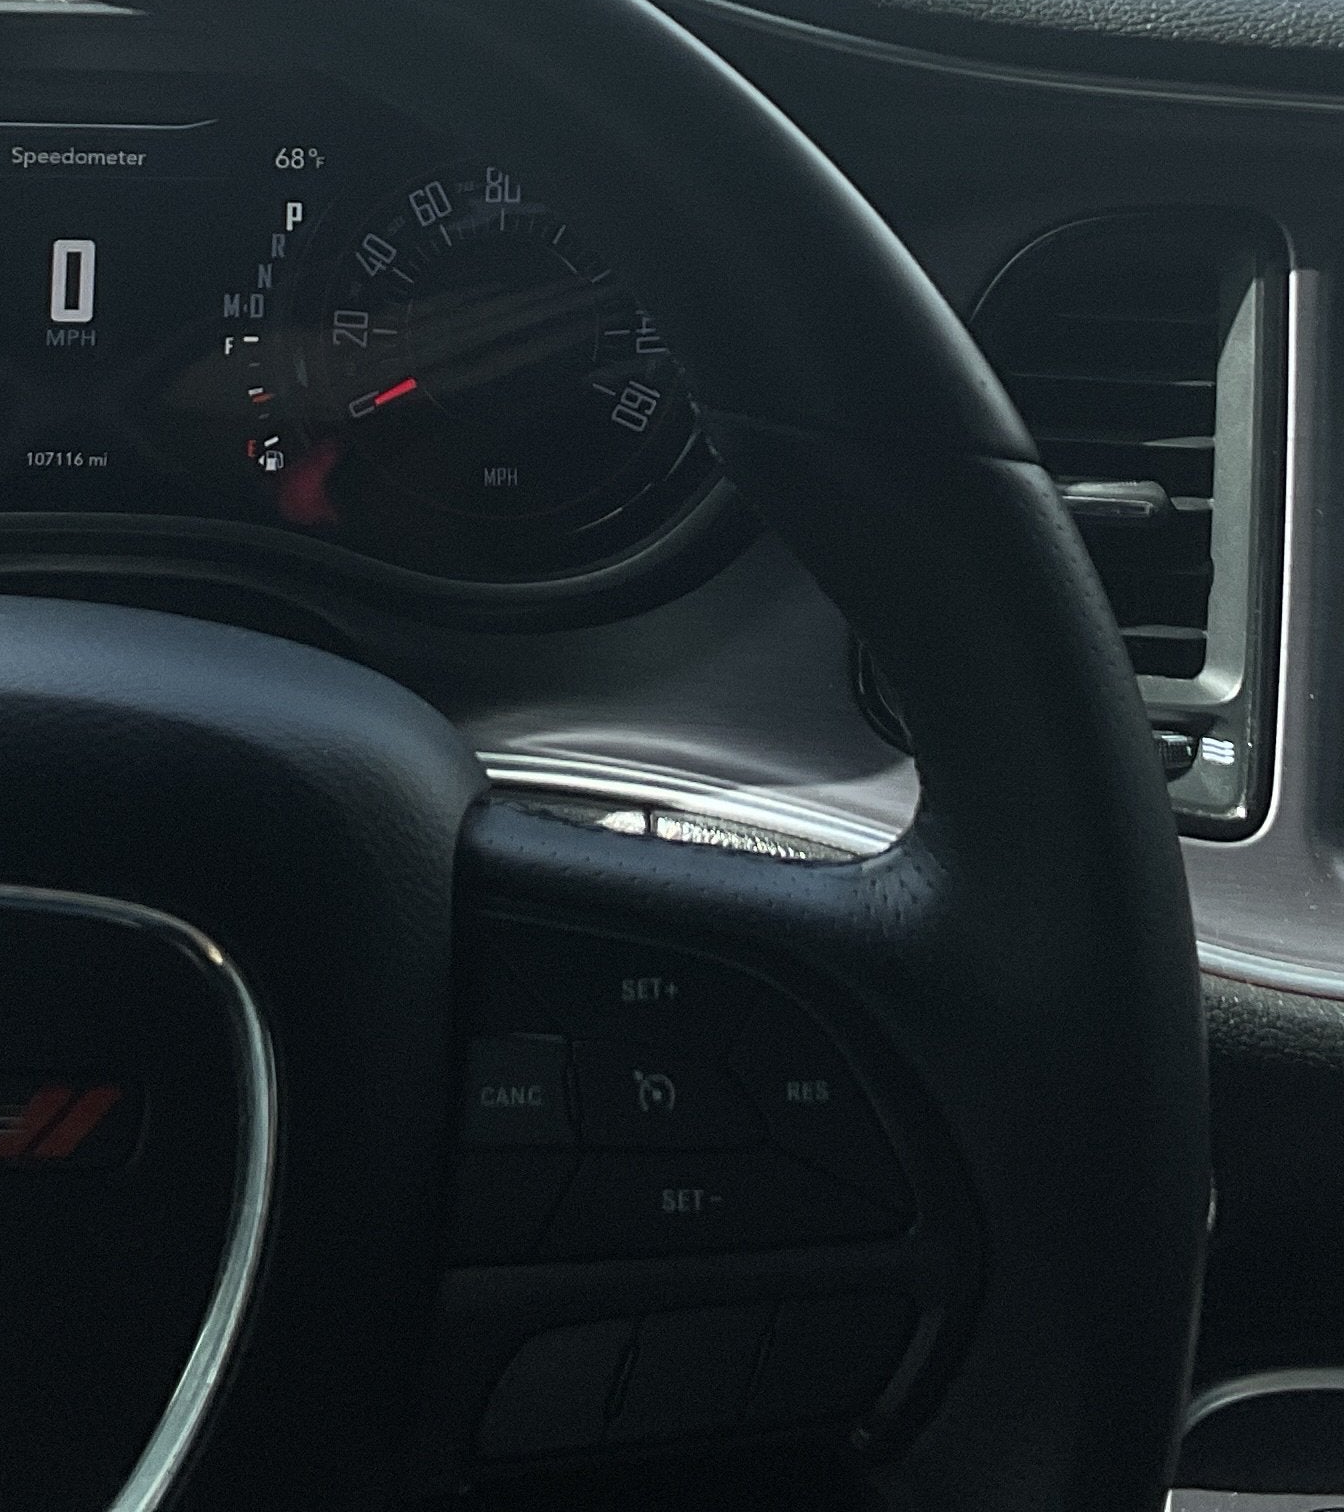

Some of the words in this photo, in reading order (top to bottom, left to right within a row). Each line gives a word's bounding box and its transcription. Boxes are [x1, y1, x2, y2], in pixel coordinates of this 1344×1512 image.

[11, 146, 147, 168] Speedometer
[286, 201, 304, 232] P
[408, 180, 453, 228] 60
[271, 233, 286, 259] R
[355, 232, 398, 277] 40
[49, 239, 97, 323] 0
[258, 263, 273, 289] N
[46, 329, 97, 348] MPH
[332, 310, 369, 348] 20
[224, 336, 234, 355] F
[611, 380, 662, 434] 160
[26, 451, 84, 468] 107116
[88, 451, 108, 468] mi
[483, 467, 519, 488] MPH
[480, 1086, 543, 1107] CANC
[786, 1080, 831, 1102] RES
